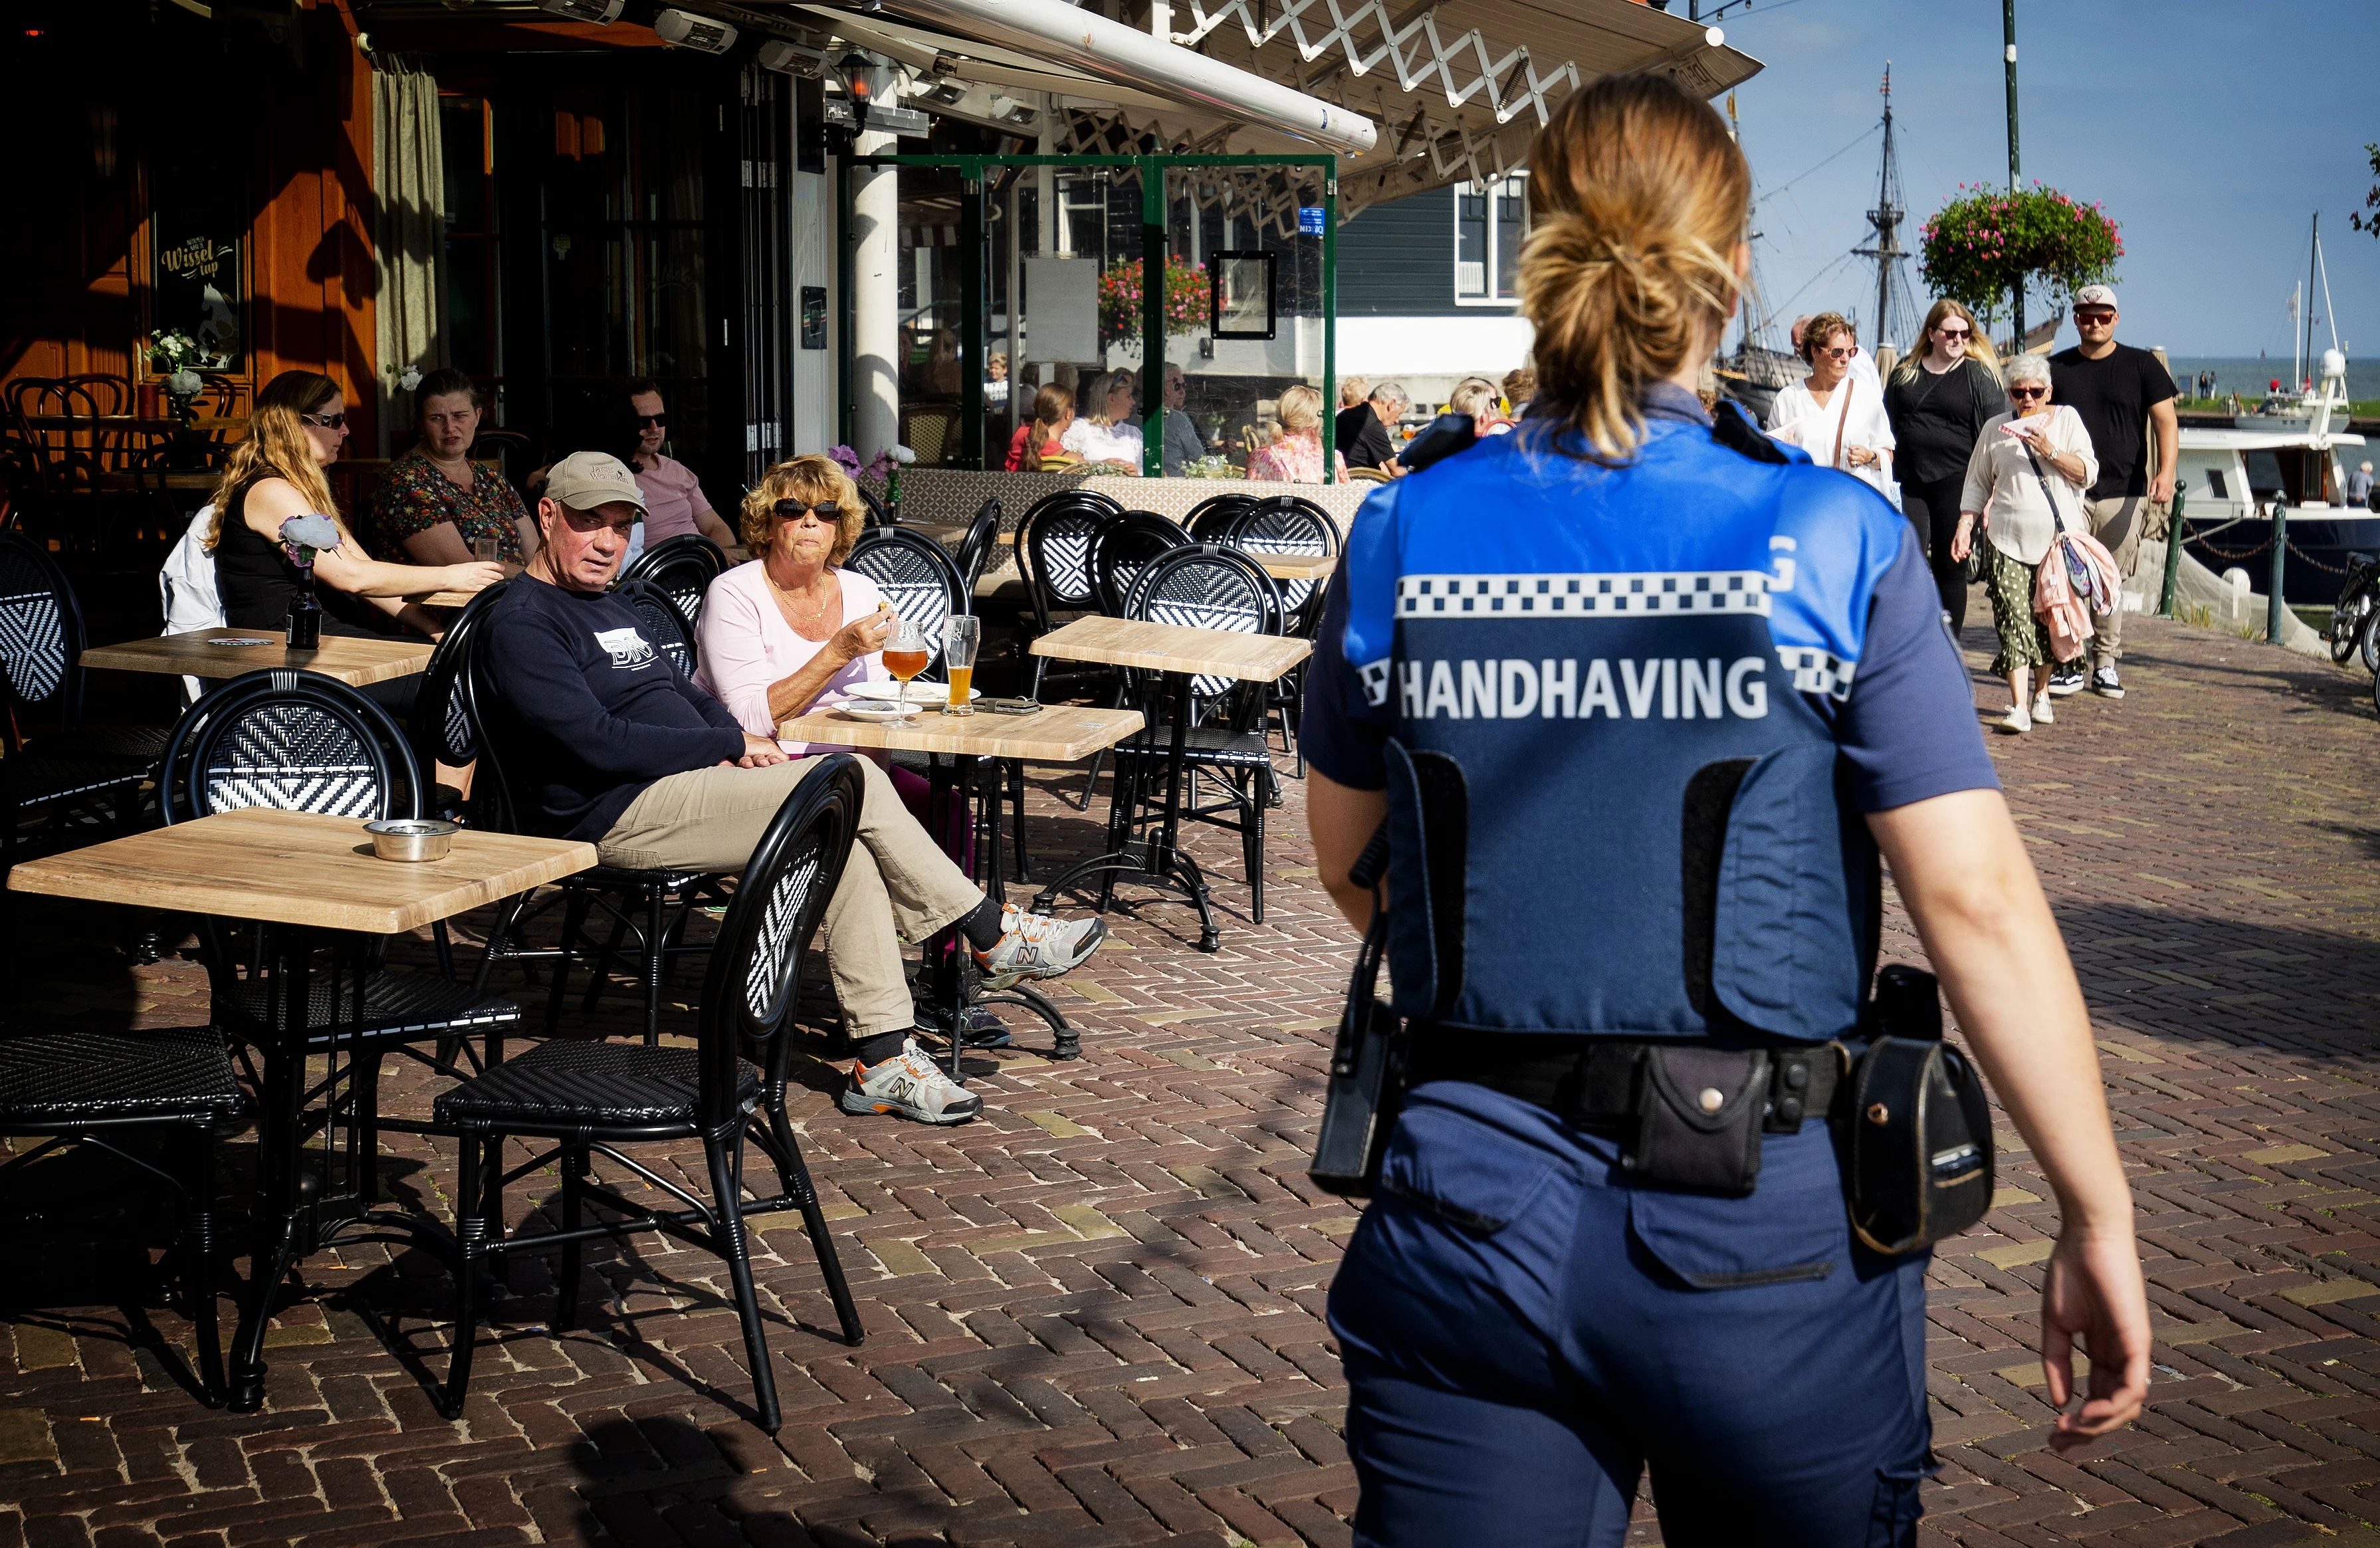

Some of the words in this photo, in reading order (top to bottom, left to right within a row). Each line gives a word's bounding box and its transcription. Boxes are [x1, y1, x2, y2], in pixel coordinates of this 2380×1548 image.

[162, 239, 213, 272] Wissel
[590, 472, 629, 485] Wolfskin
[1398, 657, 1768, 719] HANDHAVING
